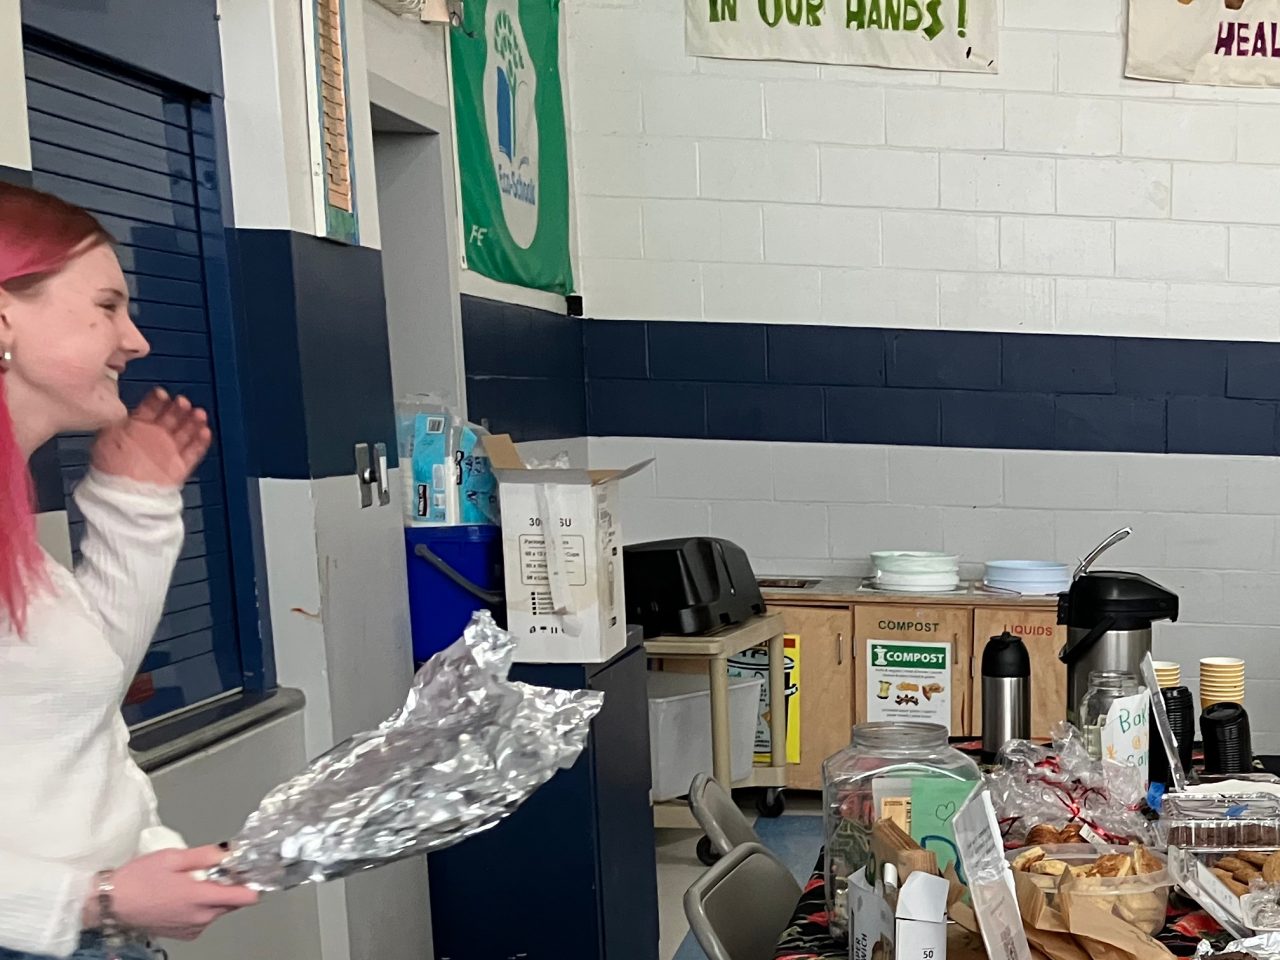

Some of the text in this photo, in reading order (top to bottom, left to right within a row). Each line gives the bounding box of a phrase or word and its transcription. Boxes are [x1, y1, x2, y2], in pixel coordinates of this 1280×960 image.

[878, 620, 940, 633] COMPOST
[886, 651, 945, 664] COMPOST
[922, 950, 934, 959] 50
